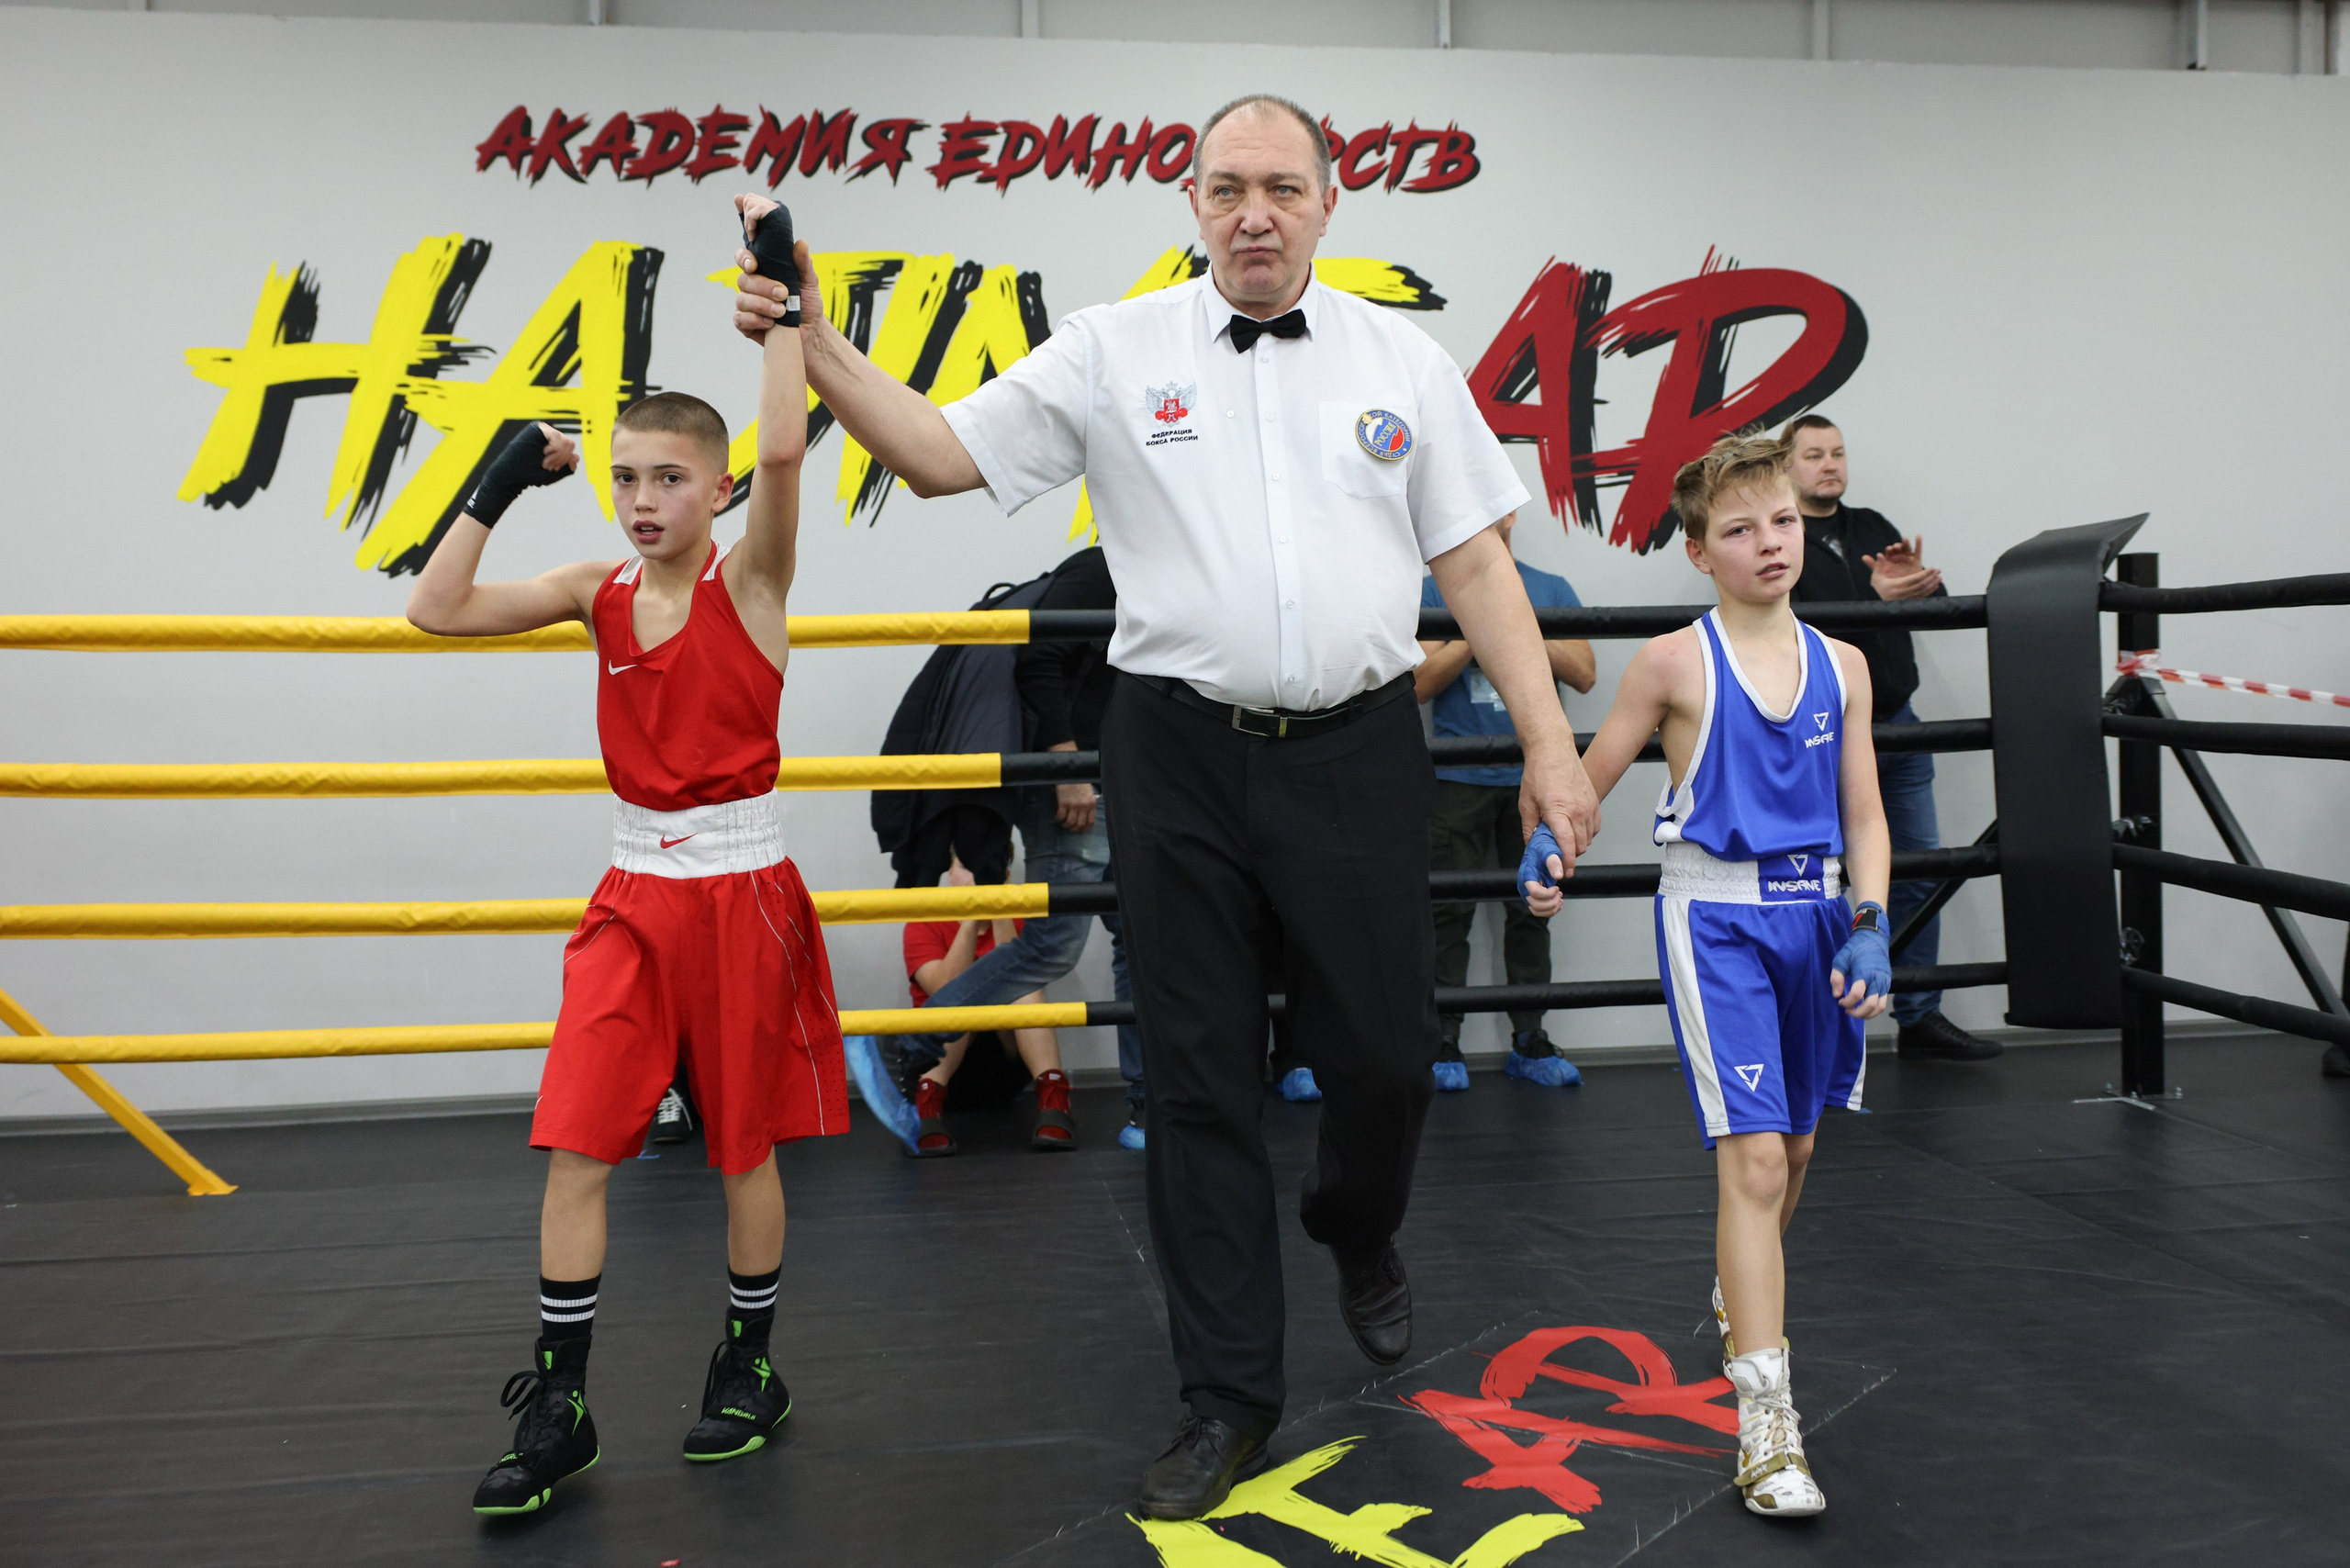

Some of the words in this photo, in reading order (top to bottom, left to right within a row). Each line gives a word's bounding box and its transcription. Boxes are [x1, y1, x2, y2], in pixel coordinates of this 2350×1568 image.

[476, 104, 930, 191] АКАДЕМИЯ
[925, 110, 1482, 196] ЕДИНОСТВ
[1151, 429, 1192, 439] ФЕДЕРАЦИЯ
[1146, 438, 1169, 446] БОКСА
[1804, 731, 1835, 749] INSAE
[1767, 879, 1822, 892] INSANE
